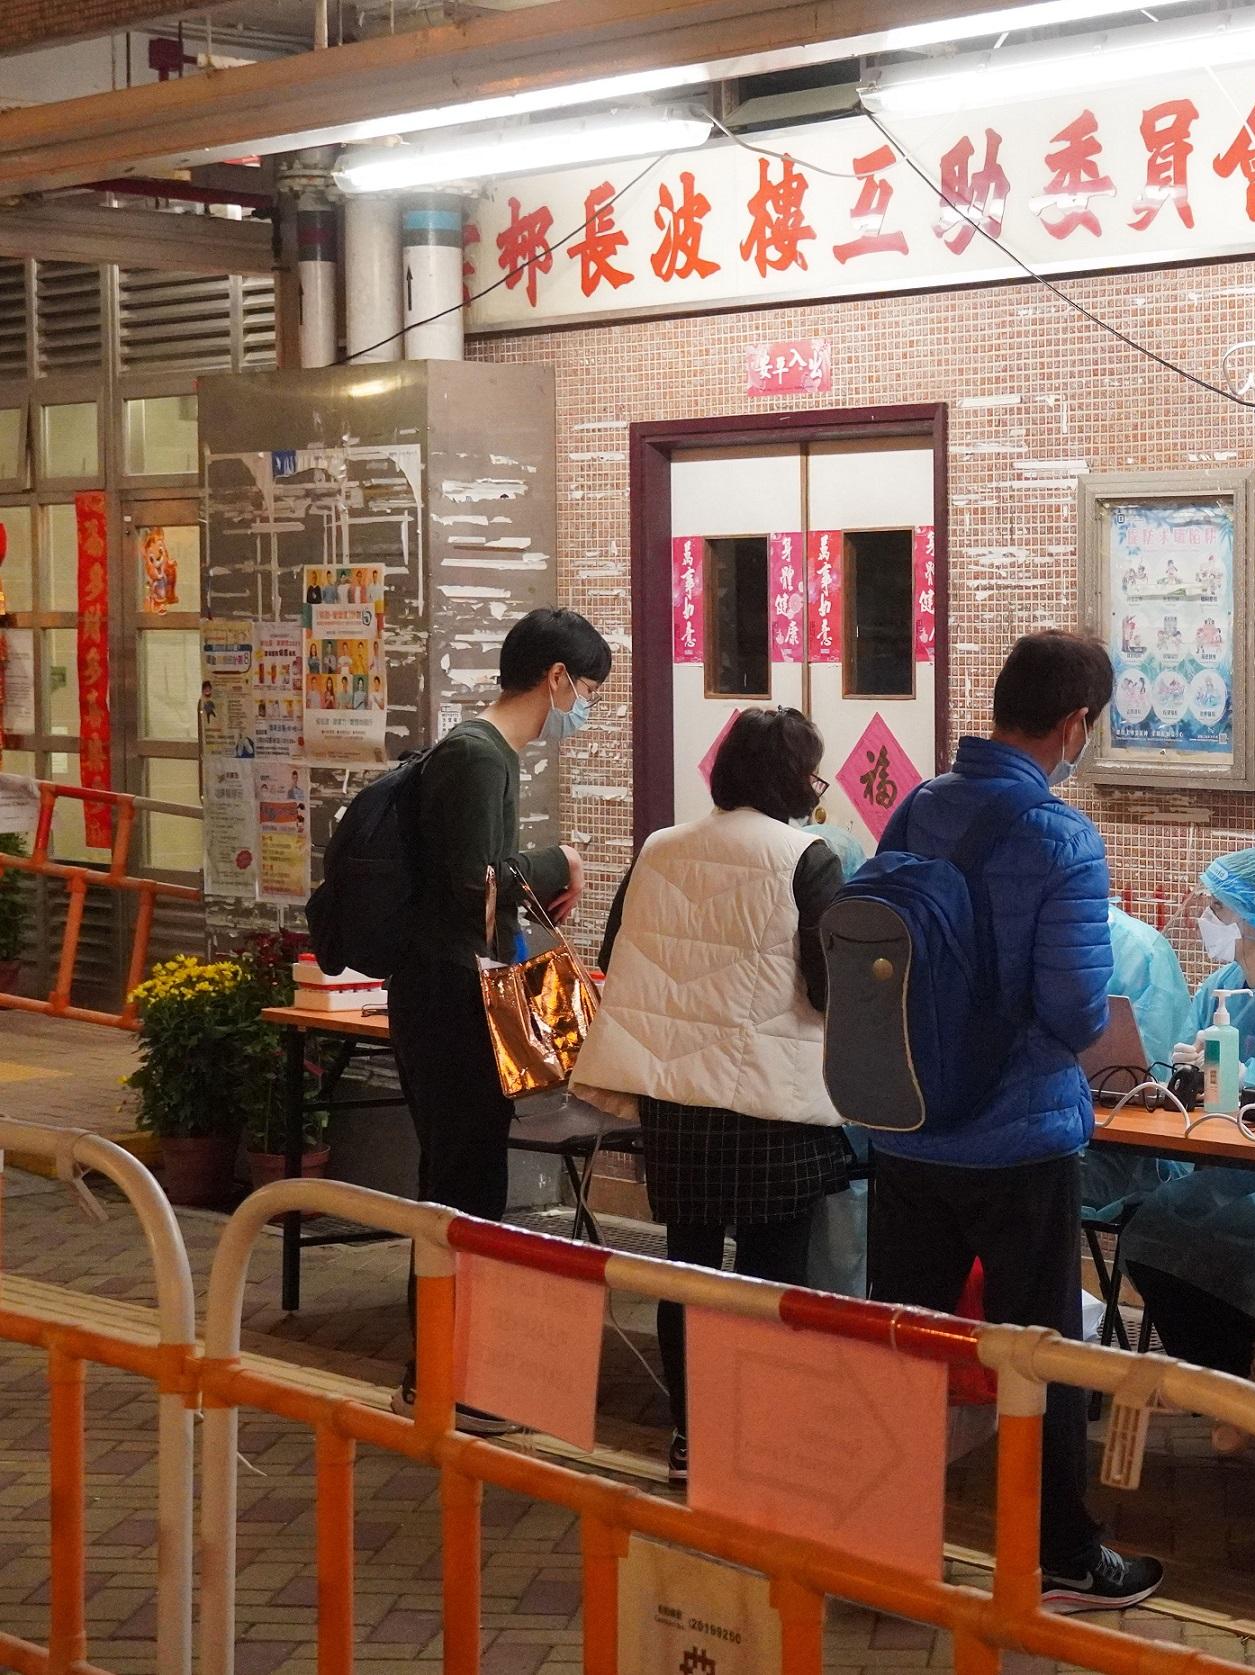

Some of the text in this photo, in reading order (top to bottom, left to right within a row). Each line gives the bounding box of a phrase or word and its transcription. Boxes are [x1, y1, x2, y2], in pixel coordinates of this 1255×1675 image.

[680, 540, 696, 647] 萬事如意
[816, 534, 833, 646] 萬事如意
[860, 745, 897, 809] 福
